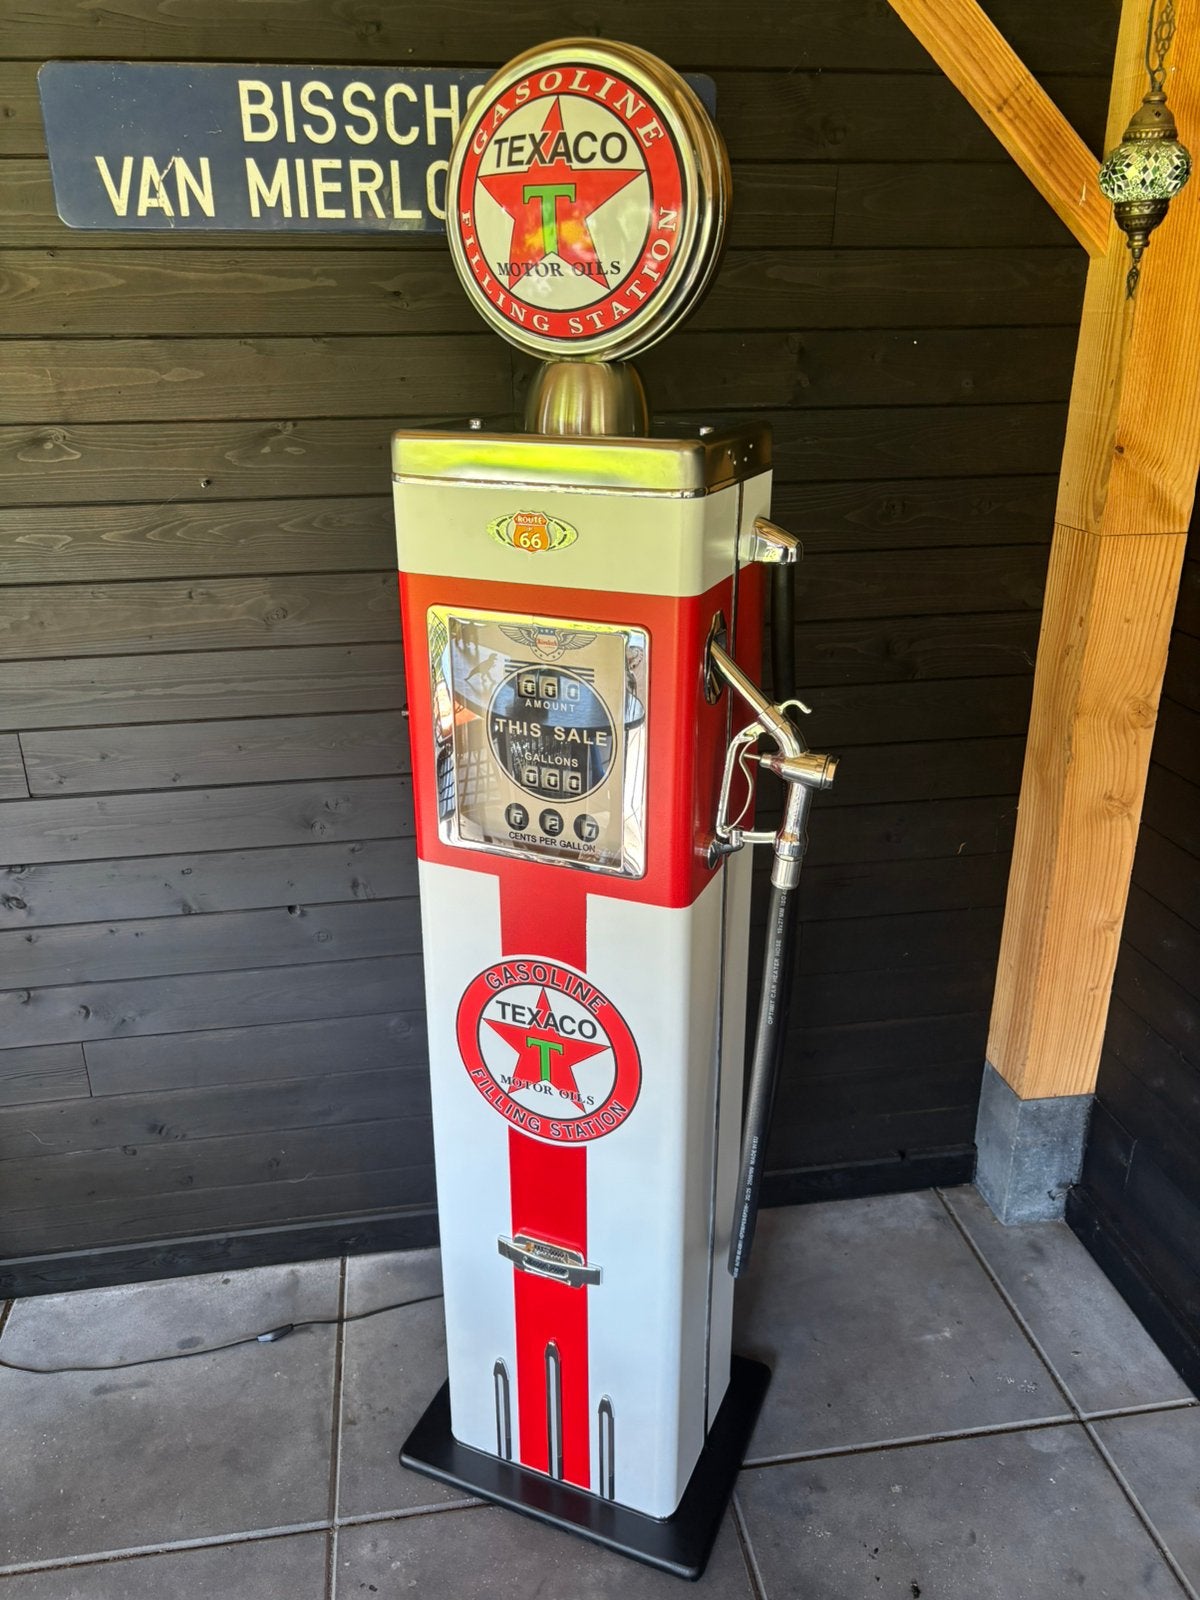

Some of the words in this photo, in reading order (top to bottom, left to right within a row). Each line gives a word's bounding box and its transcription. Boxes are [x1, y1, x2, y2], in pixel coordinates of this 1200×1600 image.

[238, 80, 484, 146] BISSCH
[472, 69, 664, 155] GASOLINE
[494, 130, 628, 168] TEXACO
[95, 156, 215, 218] VAN
[523, 183, 576, 254] T
[460, 210, 550, 332] FILLING
[569, 207, 678, 335] STATION
[497, 262, 564, 277] MOTOR
[572, 260, 621, 276] OILS
[517, 515, 543, 525] ROUTE
[520, 533, 542, 549] 66
[525, 699, 575, 712] AMOUNT
[495, 718, 541, 738] THIS
[554, 726, 608, 746] SALE
[524, 752, 579, 768] GALLONS
[508, 831, 537, 843] CENTS
[539, 836, 557, 847] PER
[560, 840, 596, 853] GALLON
[485, 963, 606, 1013] GASOLINE
[496, 1000, 597, 1039] TEXACO
[526, 1036, 564, 1081] T
[472, 1068, 540, 1131] FILLING
[550, 1101, 627, 1138] STATION
[500, 1074, 553, 1096] MOTOR
[559, 1088, 595, 1106] OILS
